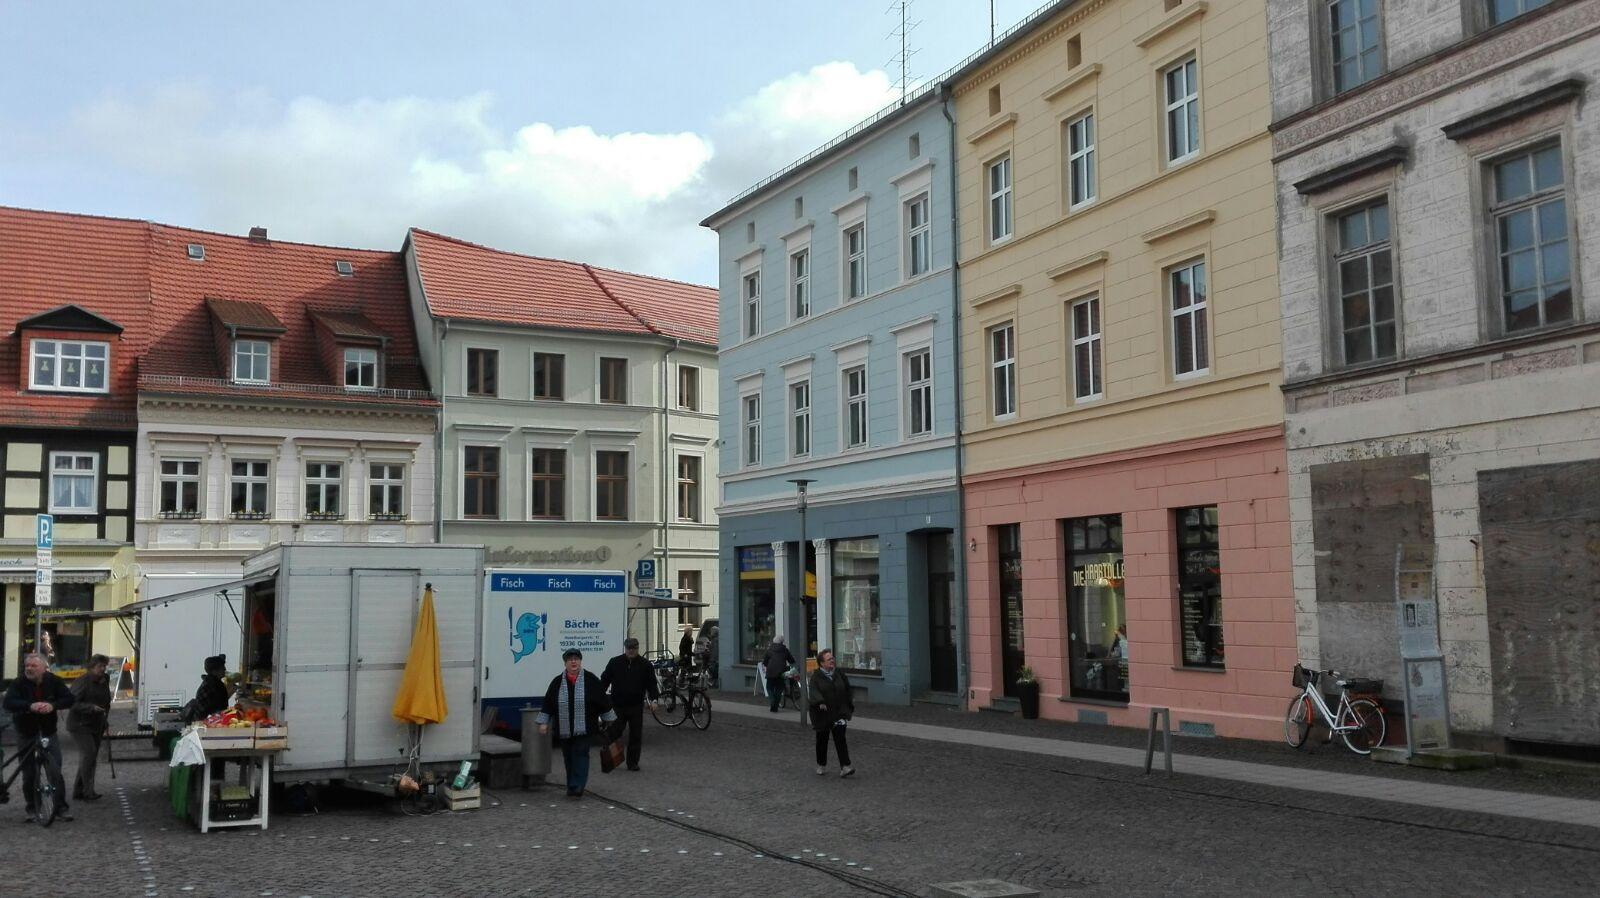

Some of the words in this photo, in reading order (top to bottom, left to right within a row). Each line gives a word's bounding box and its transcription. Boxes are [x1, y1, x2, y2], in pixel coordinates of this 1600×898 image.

[40, 518, 50, 544] P
[641, 561, 652, 576] P
[500, 577, 525, 588] Fisch
[548, 578, 571, 589] Fisch
[593, 579, 616, 589] Fisch
[1073, 570, 1085, 587] DIE
[564, 619, 601, 629] Bächer
